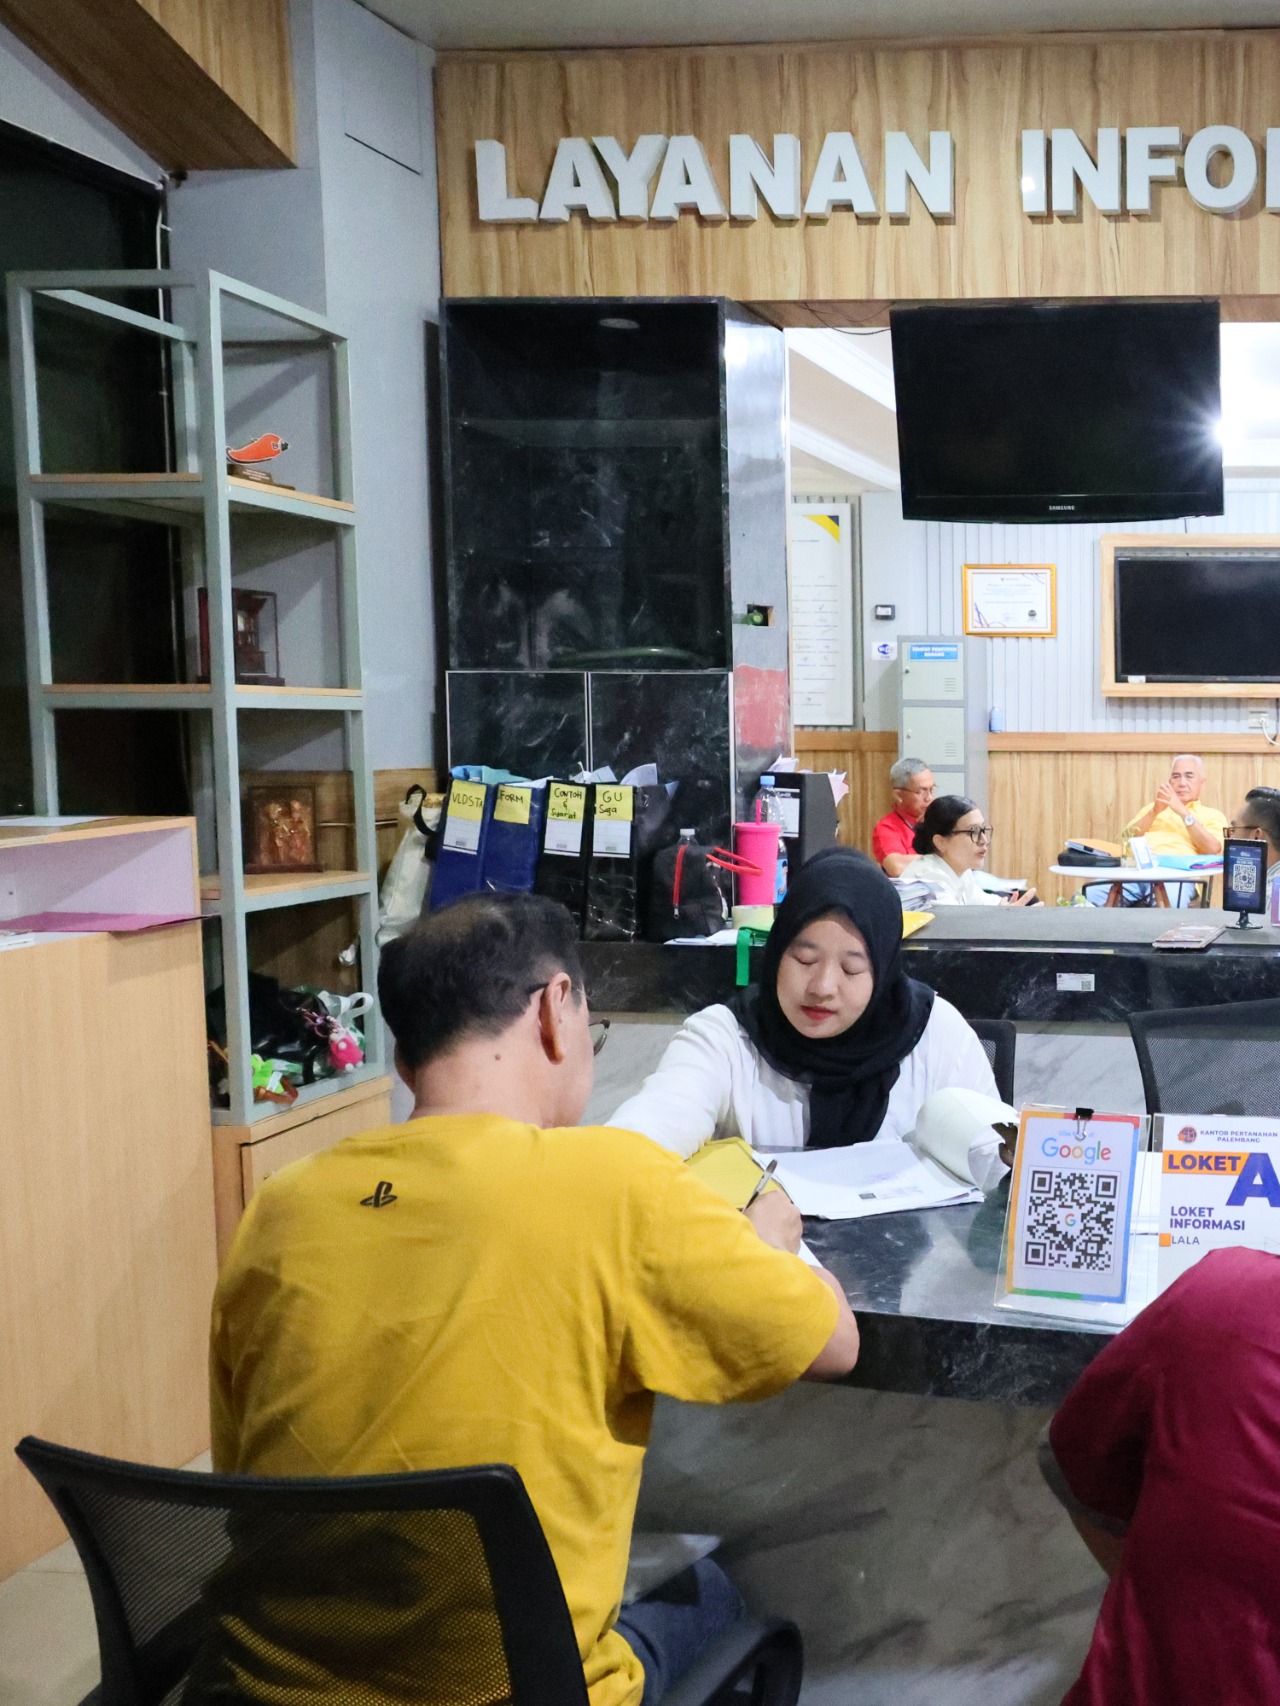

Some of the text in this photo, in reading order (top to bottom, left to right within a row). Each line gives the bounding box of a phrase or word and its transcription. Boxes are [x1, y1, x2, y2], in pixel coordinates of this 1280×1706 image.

[475, 130, 955, 222] LAYANAN
[602, 790, 623, 804] GU
[1041, 1137, 1112, 1165] Google
[1168, 1154, 1241, 1172] LOKET
[1170, 1206, 1214, 1217] LOKET
[1169, 1218, 1245, 1231] INFORMASI
[1171, 1236, 1200, 1245] LALA
